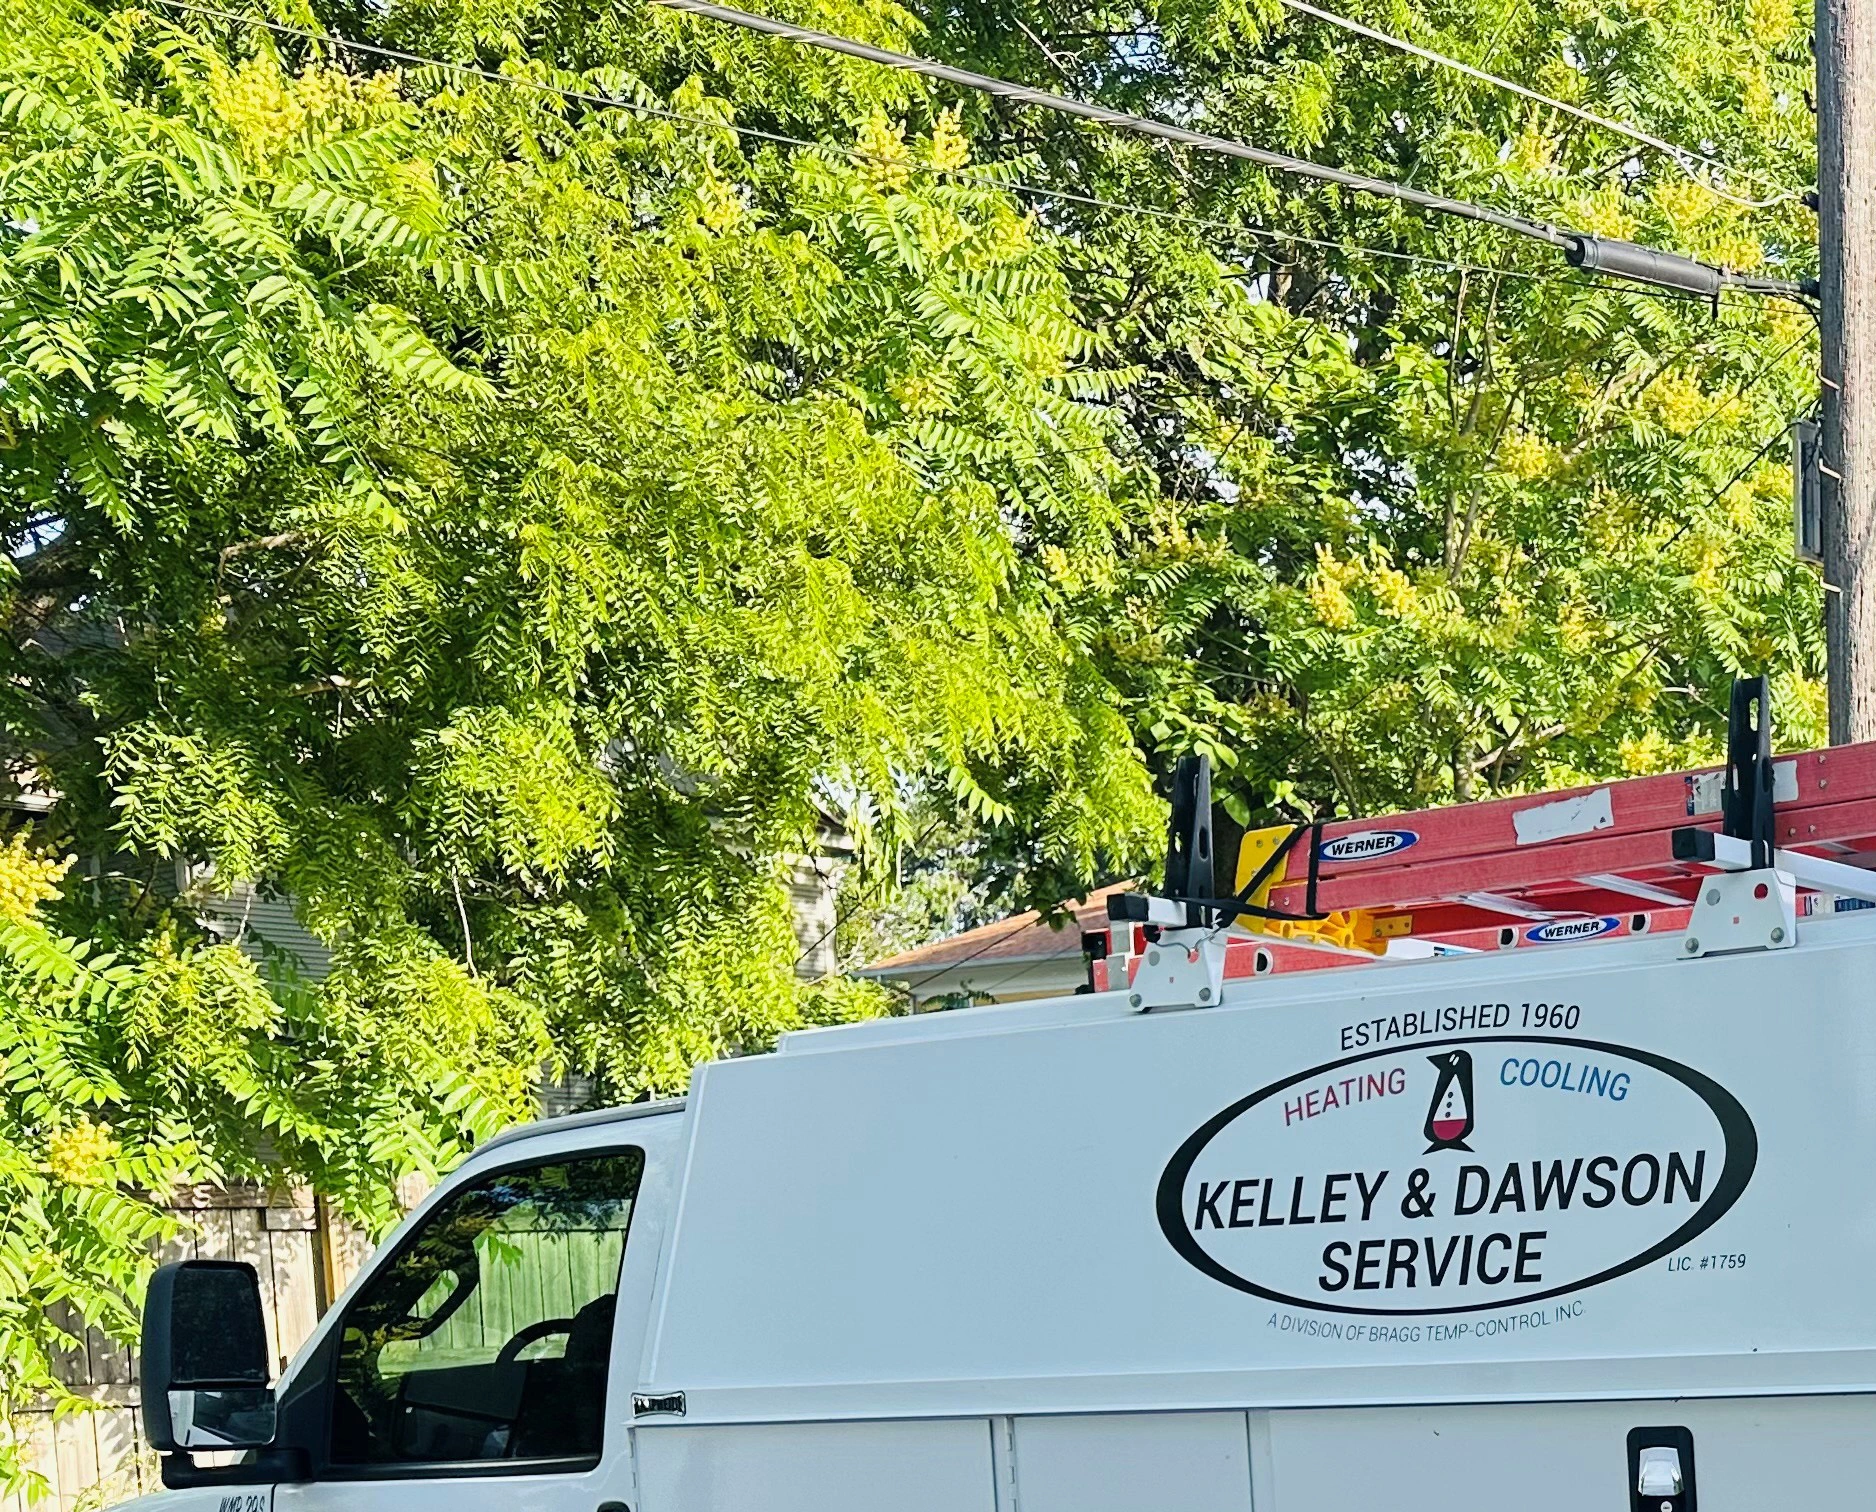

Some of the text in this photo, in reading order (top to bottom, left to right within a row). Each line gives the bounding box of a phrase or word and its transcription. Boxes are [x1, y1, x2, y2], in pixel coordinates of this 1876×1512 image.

[1331, 835, 1397, 855] WERNER
[1543, 920, 1600, 939] WERNER
[1340, 1002, 1581, 1051] ESTABLISHED 1960
[1283, 1067, 1407, 1127] HEATING
[1499, 1057, 1632, 1101] COOLING
[1193, 1150, 1707, 1231] KELLEY & DAWSON
[1317, 1230, 1548, 1292] SERVICE
[1667, 1253, 1747, 1272] LIC. #1759
[1267, 1299, 1587, 1342] A DIVISION OF BRAGG TEMP-CONTROL INC.
